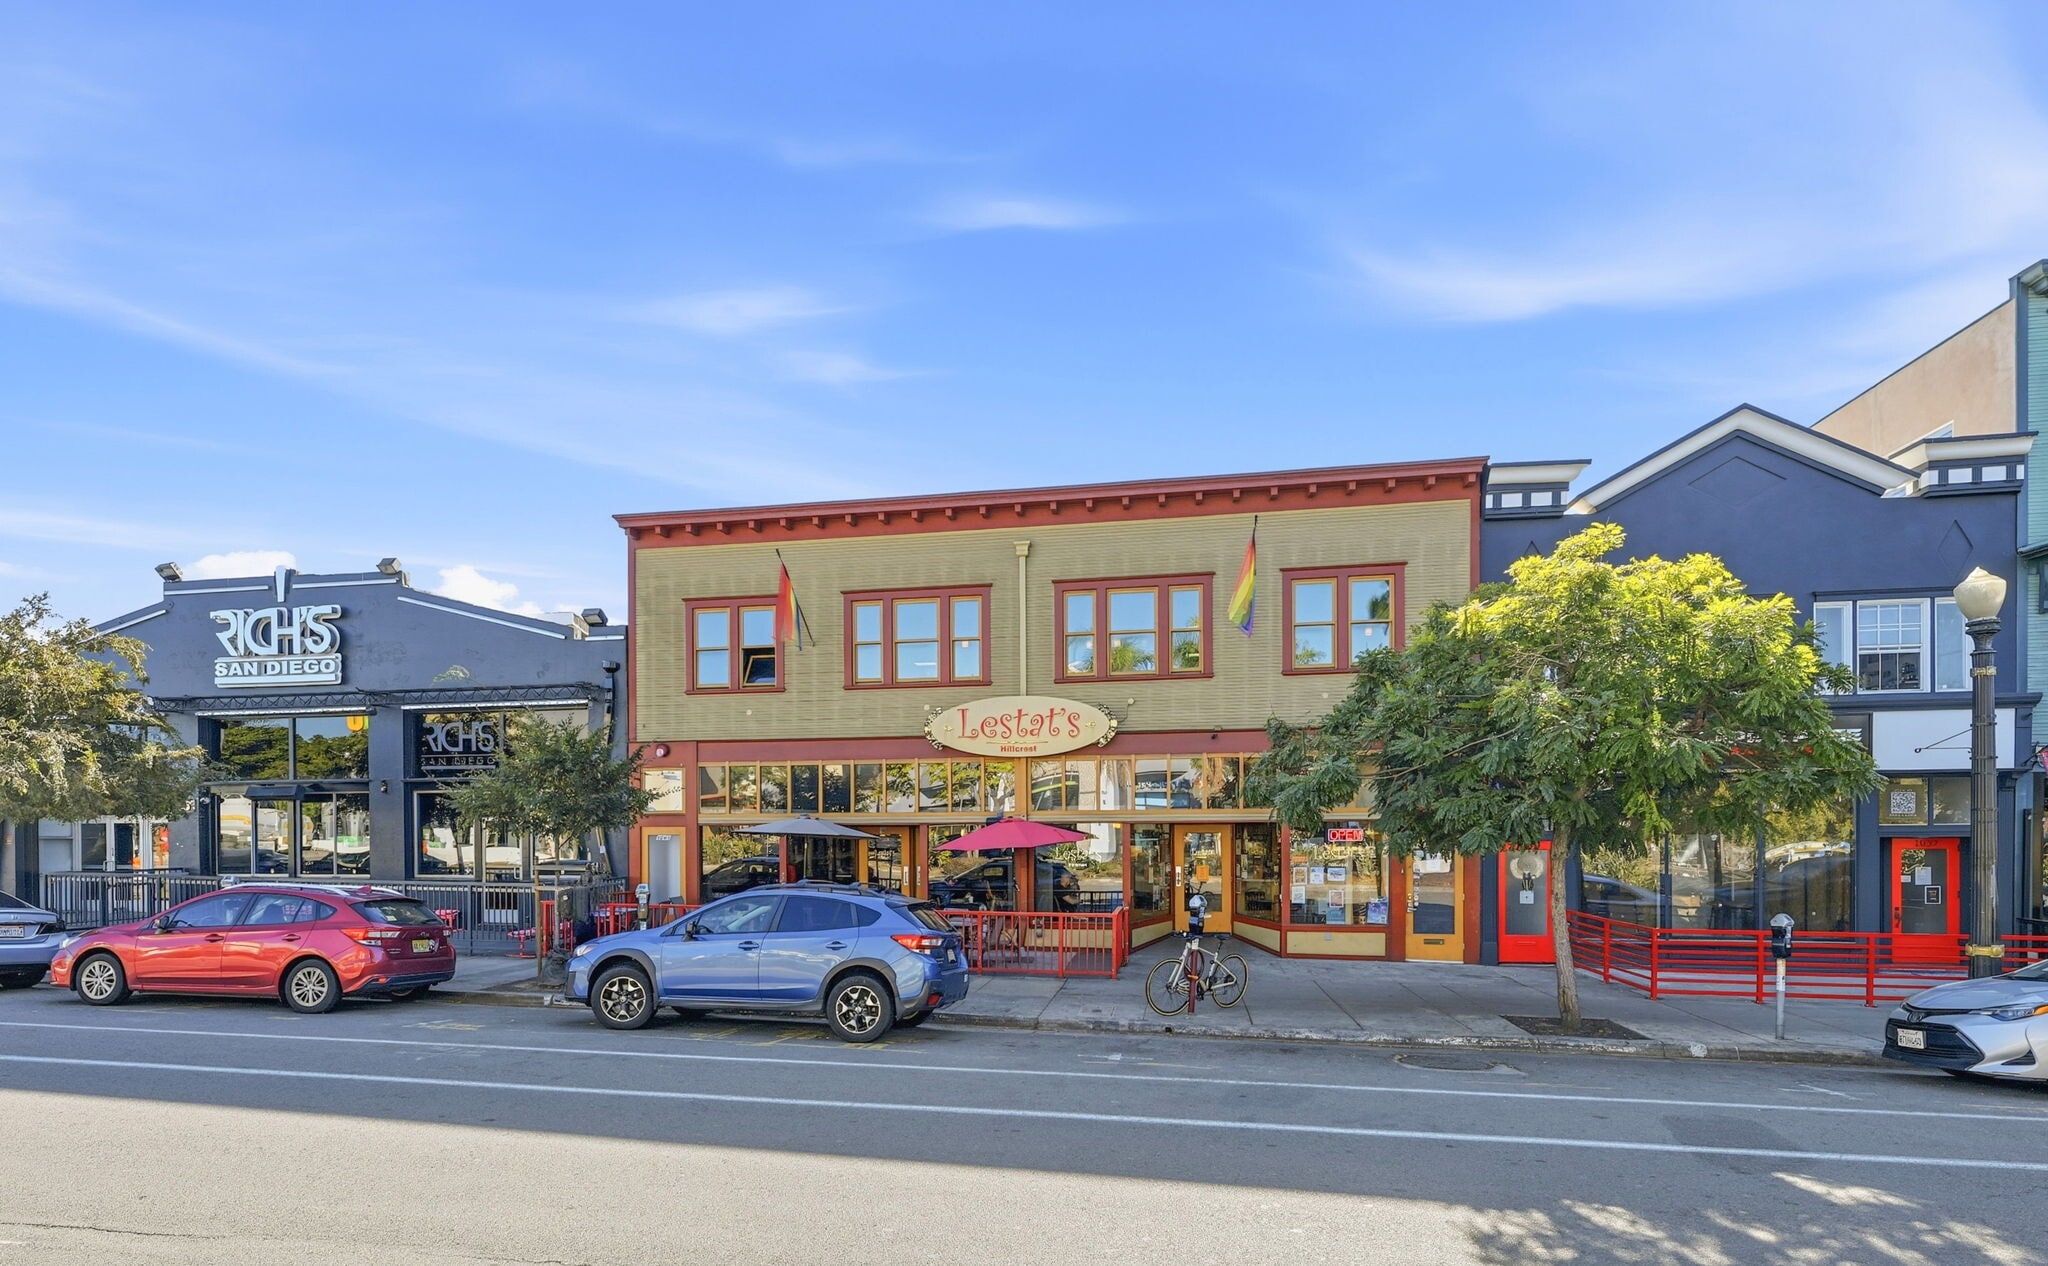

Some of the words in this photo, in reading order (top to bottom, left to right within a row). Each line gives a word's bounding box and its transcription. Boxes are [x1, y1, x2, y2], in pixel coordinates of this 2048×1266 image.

[210, 605, 339, 656] RICH'S
[214, 661, 258, 677] SAN
[265, 660, 336, 675] DIEGO
[957, 707, 1081, 739] Lestat's
[1000, 745, 1037, 753] Hillcrest
[1330, 830, 1362, 840] OPEN
